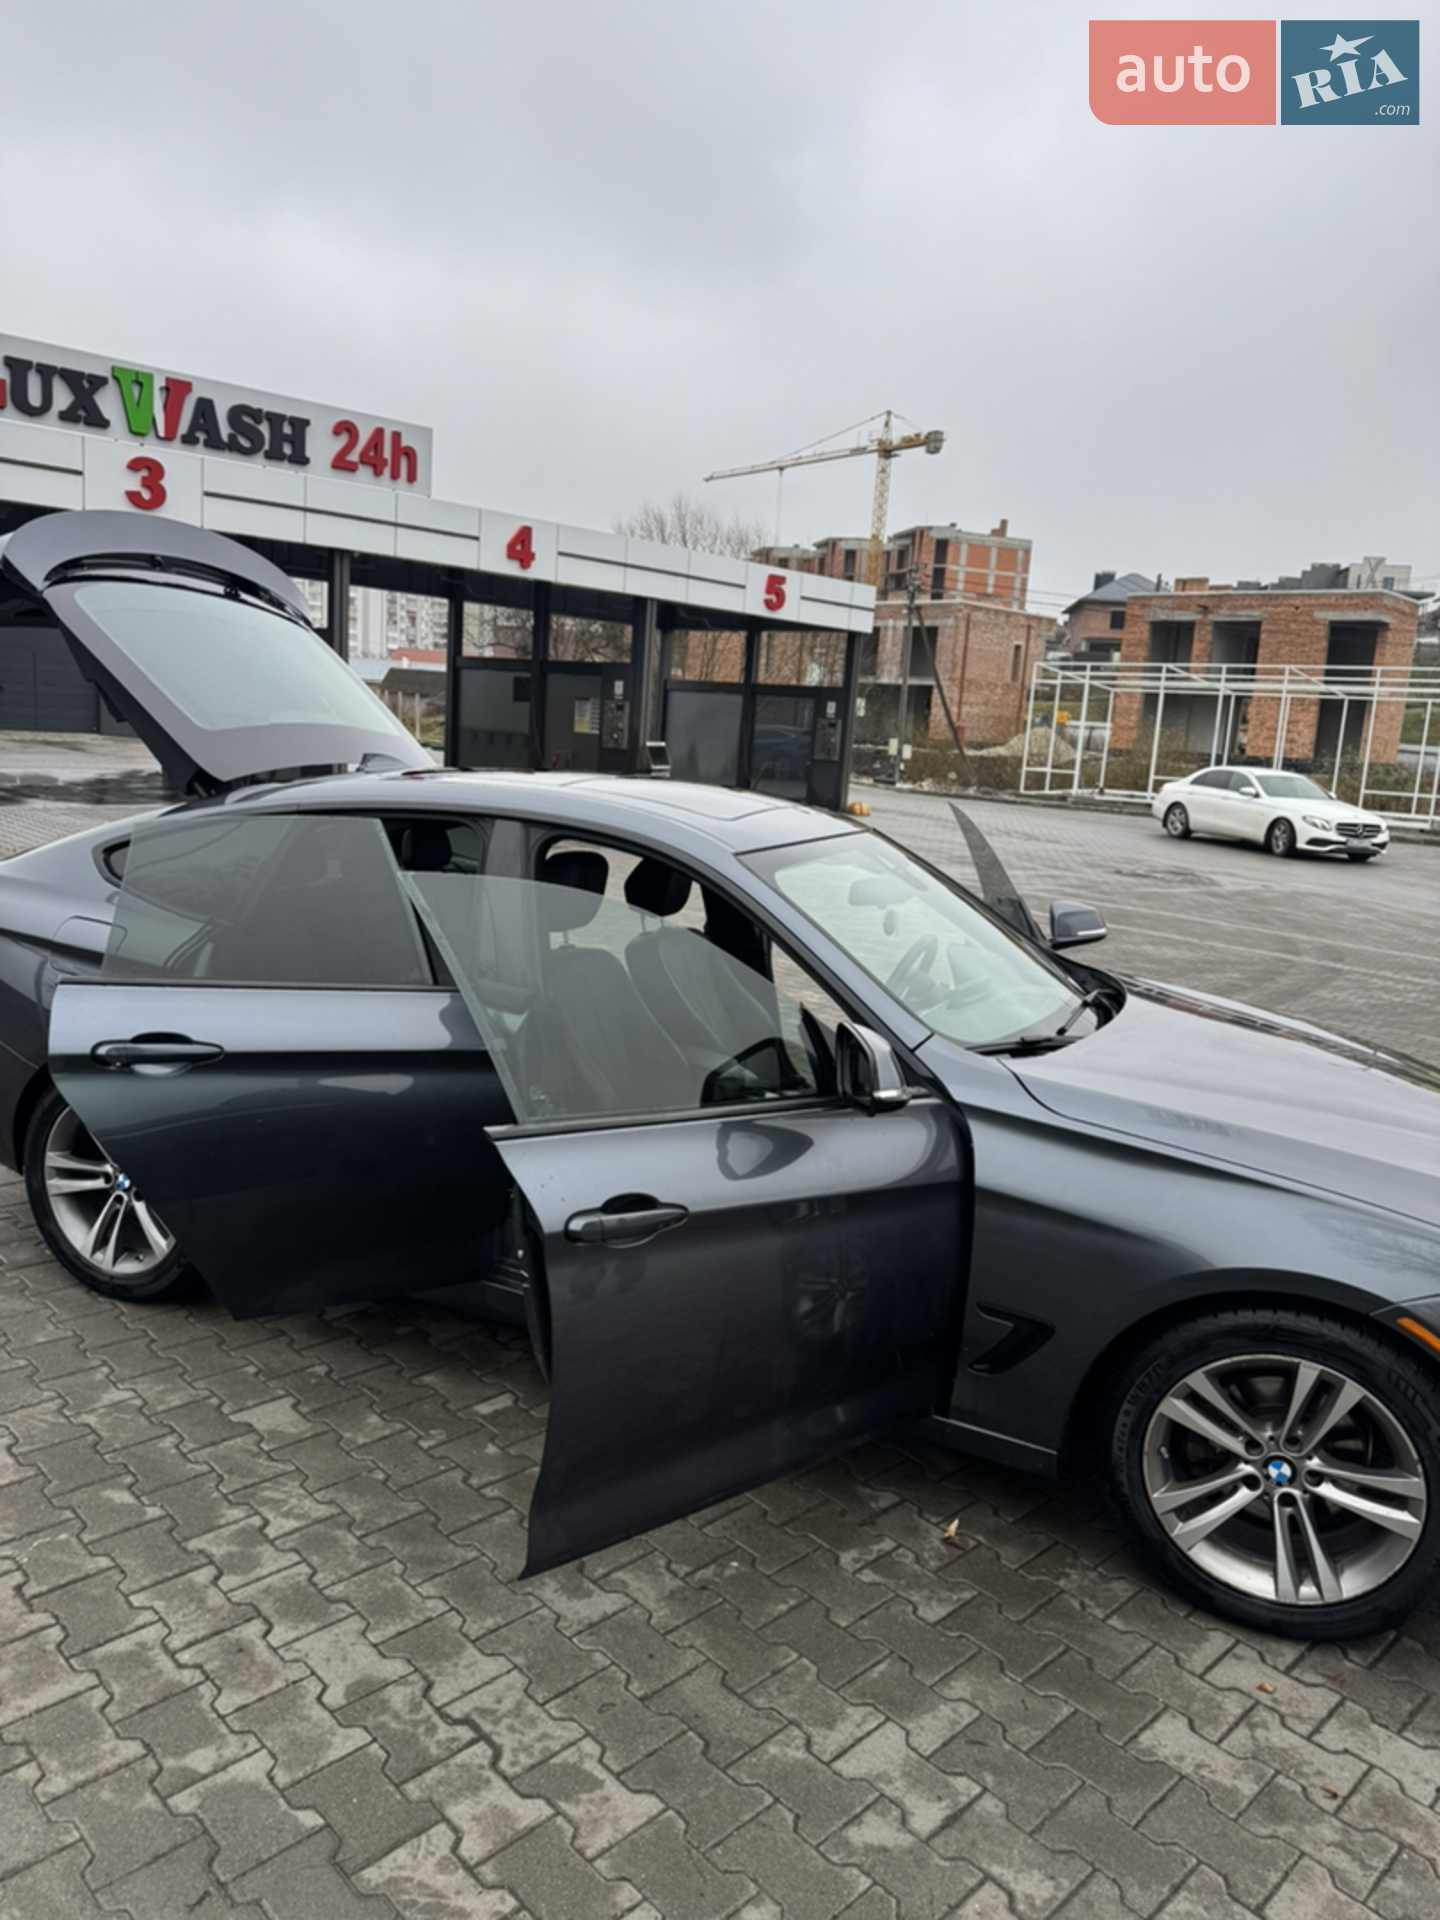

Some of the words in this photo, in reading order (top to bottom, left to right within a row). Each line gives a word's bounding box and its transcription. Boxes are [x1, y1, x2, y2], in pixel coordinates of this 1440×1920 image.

[0, 355, 311, 466] UXWASH
[331, 419, 418, 483] 24h
[124, 456, 168, 510] 3
[506, 525, 536, 570] 4
[763, 574, 787, 612] 5
